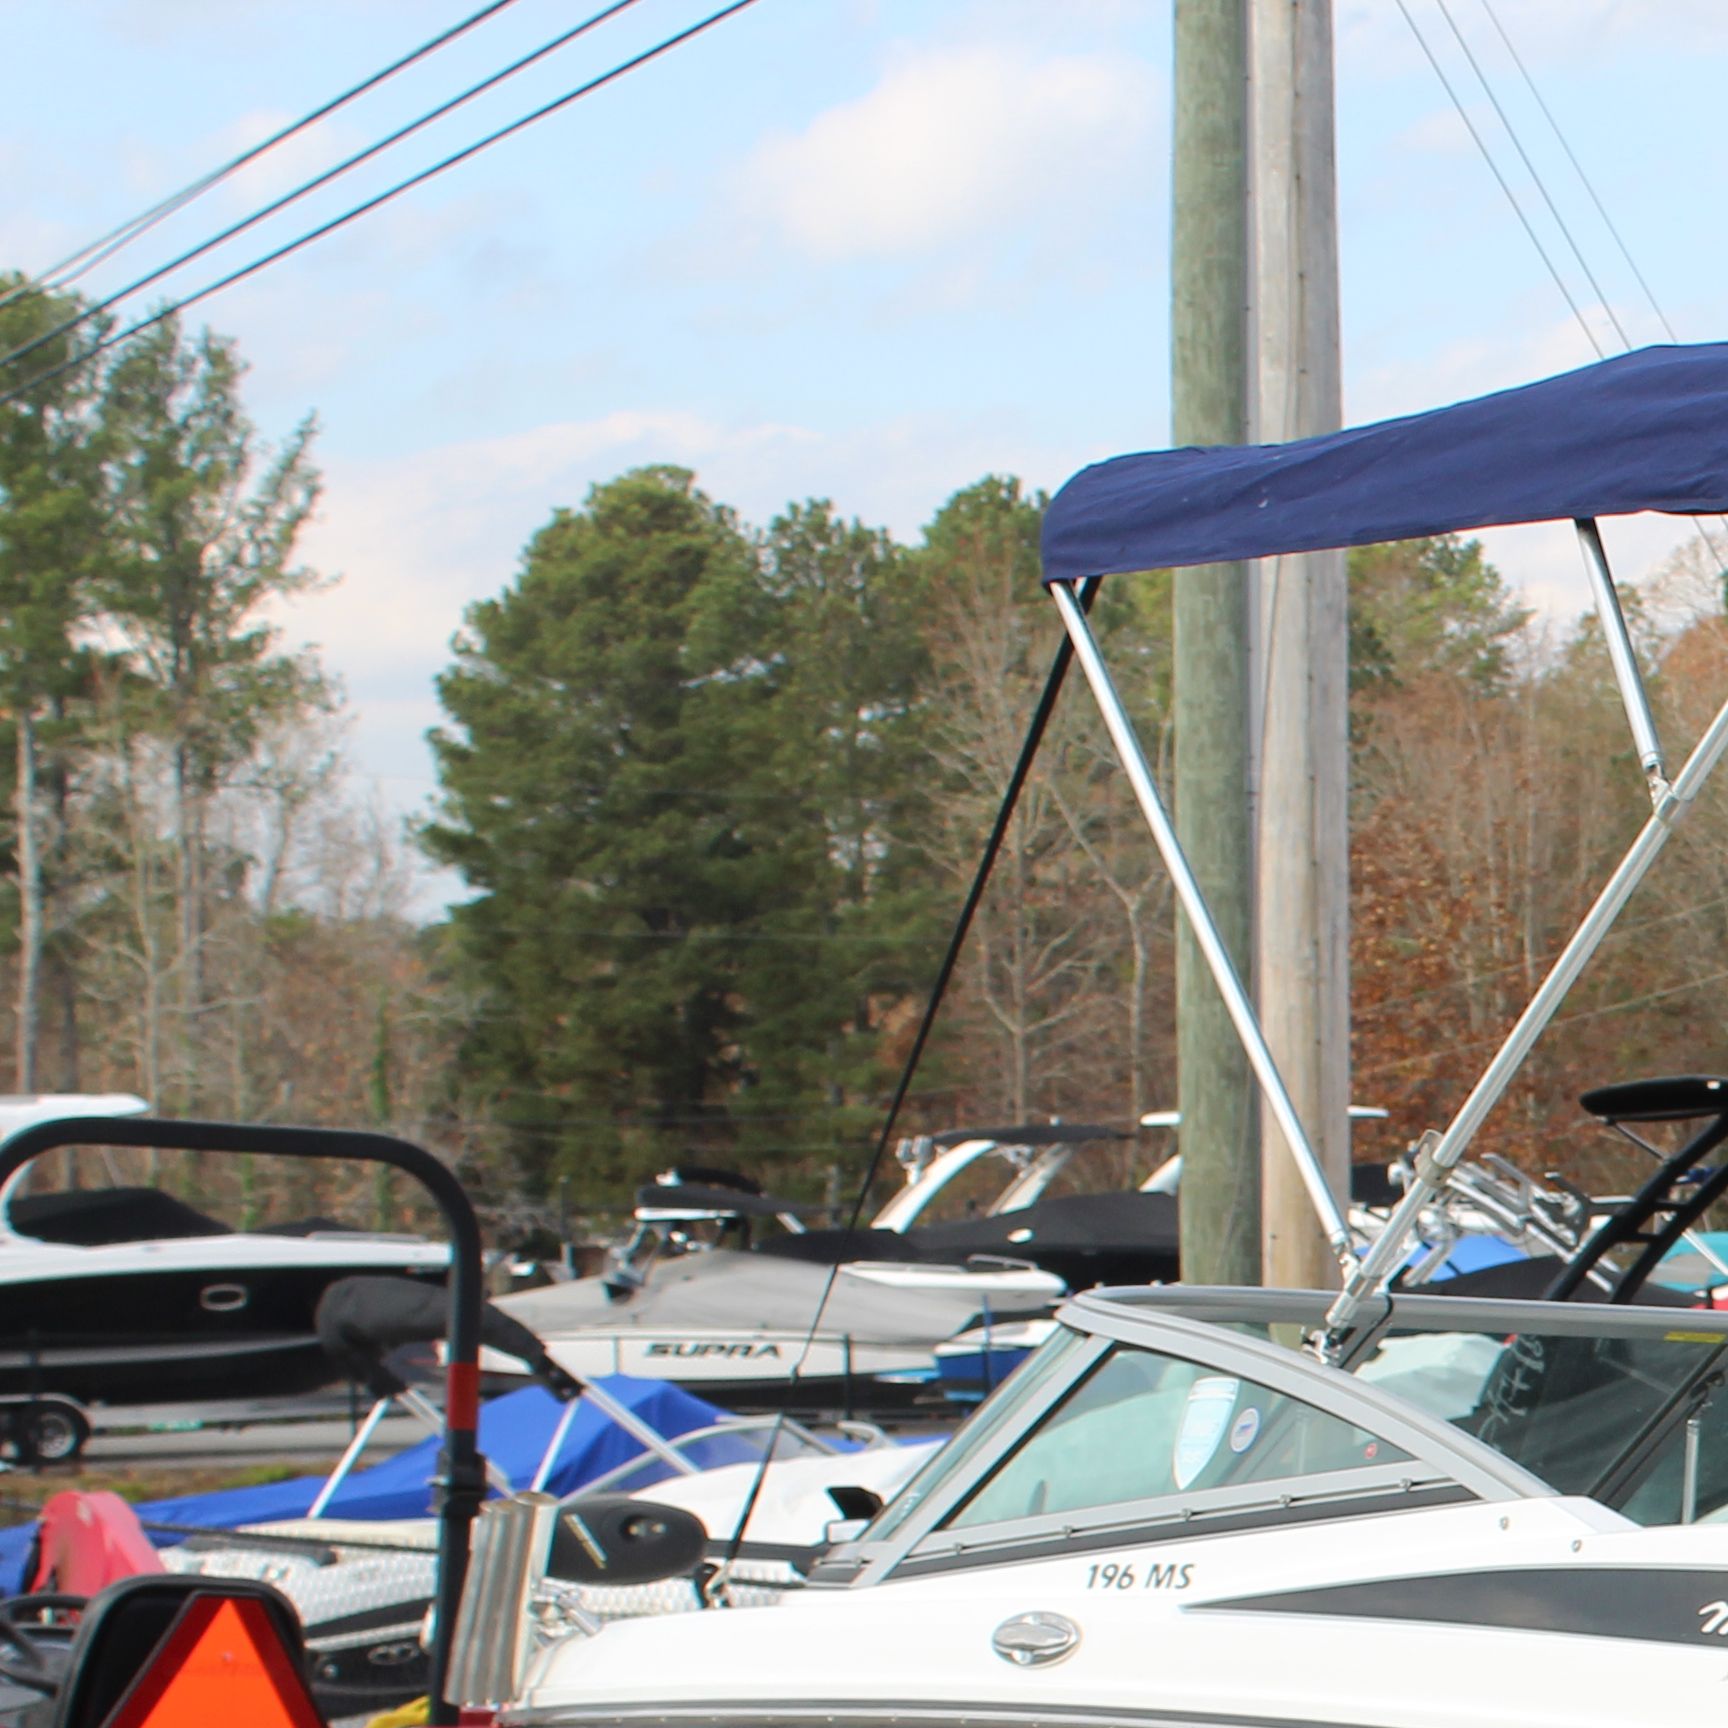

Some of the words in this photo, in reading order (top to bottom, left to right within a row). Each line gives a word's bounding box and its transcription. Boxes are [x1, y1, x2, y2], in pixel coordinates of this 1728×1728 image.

[645, 1343, 781, 1359] SUPRA
[1087, 1563, 1135, 1590] 196
[1144, 1563, 1197, 1590] MS
